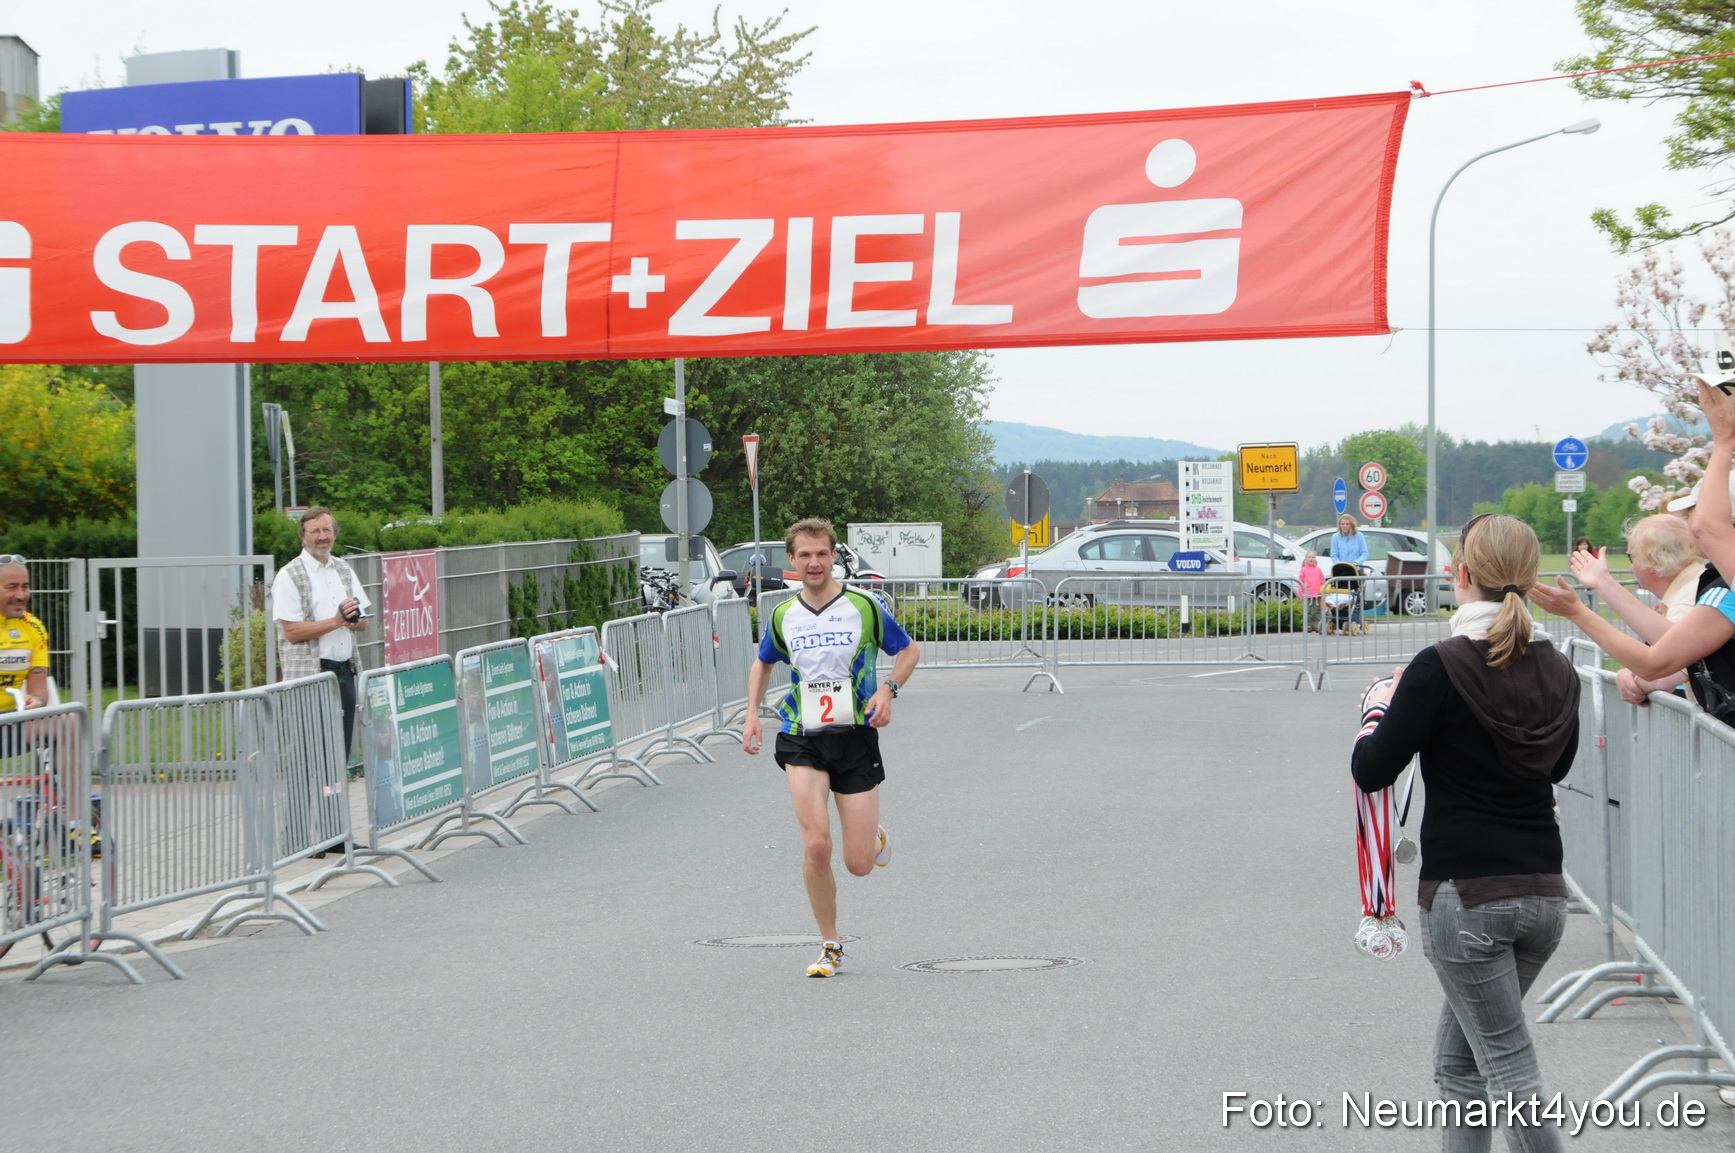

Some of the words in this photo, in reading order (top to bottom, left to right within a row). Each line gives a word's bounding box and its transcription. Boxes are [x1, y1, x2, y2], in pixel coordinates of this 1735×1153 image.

[1246, 462, 1292, 473] Neumarkt
[1366, 470, 1380, 483] 60
[1191, 523, 1208, 534] THULE
[1176, 560, 1201, 568] VOLVO
[393, 605, 433, 642] ZEITLOS
[790, 631, 853, 653] BOCK
[562, 684, 570, 701] Fun
[569, 682, 575, 699] &
[574, 680, 586, 698] Action
[586, 679, 592, 695] in
[488, 702, 497, 720] Fun
[496, 700, 501, 718] &
[500, 697, 513, 716] Action
[513, 695, 518, 713] in
[565, 707, 581, 725] sicheren
[820, 695, 834, 723] 2
[400, 727, 409, 747] Fun
[410, 725, 416, 745] &
[416, 722, 431, 742] Action
[432, 719, 438, 738] in
[490, 727, 507, 747] sicheren
[403, 754, 423, 777] sicheren
